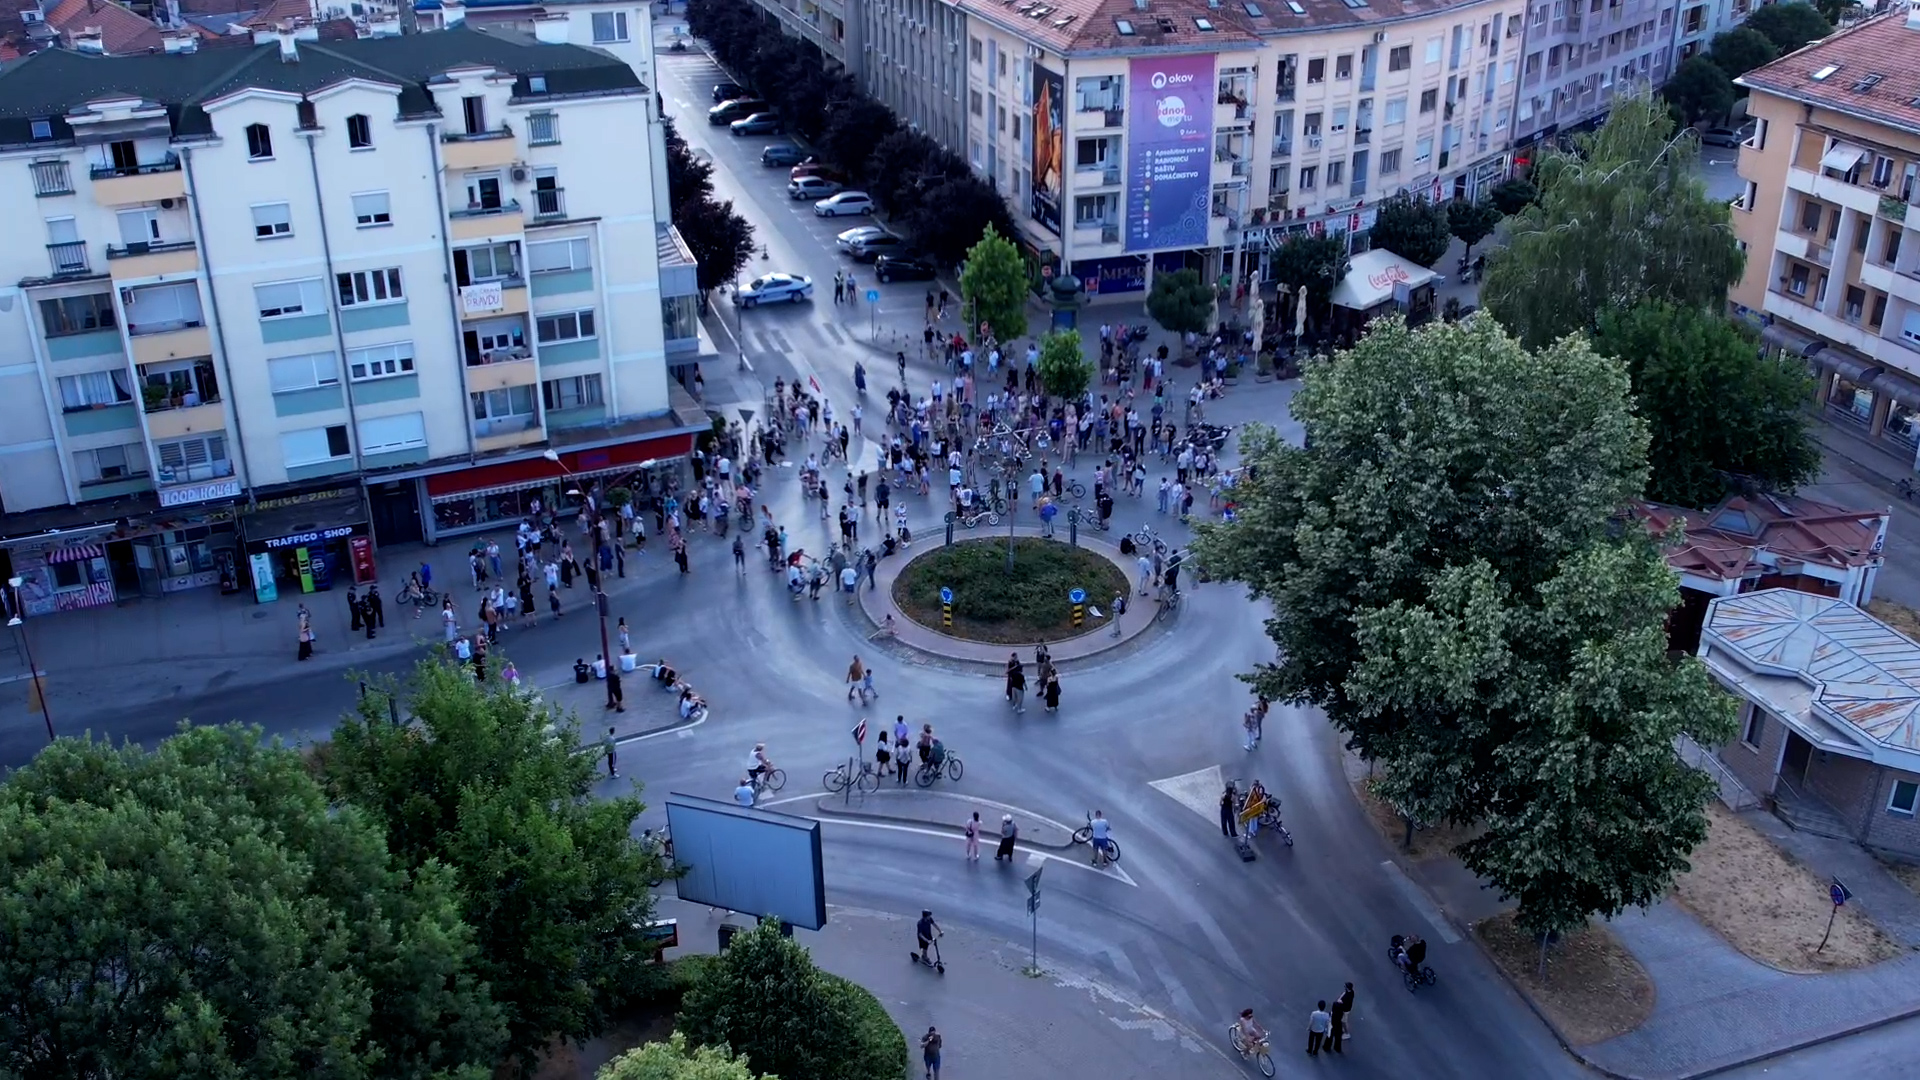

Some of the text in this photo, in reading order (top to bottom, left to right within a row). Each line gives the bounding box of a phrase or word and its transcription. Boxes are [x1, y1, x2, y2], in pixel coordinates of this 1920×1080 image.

[1168, 73, 1194, 83] okov
[466, 294, 500, 307] PRAVDU
[265, 533, 318, 548] TRAFFICO
[324, 526, 353, 539] SHOP
[1875, 534, 1883, 551] FO
